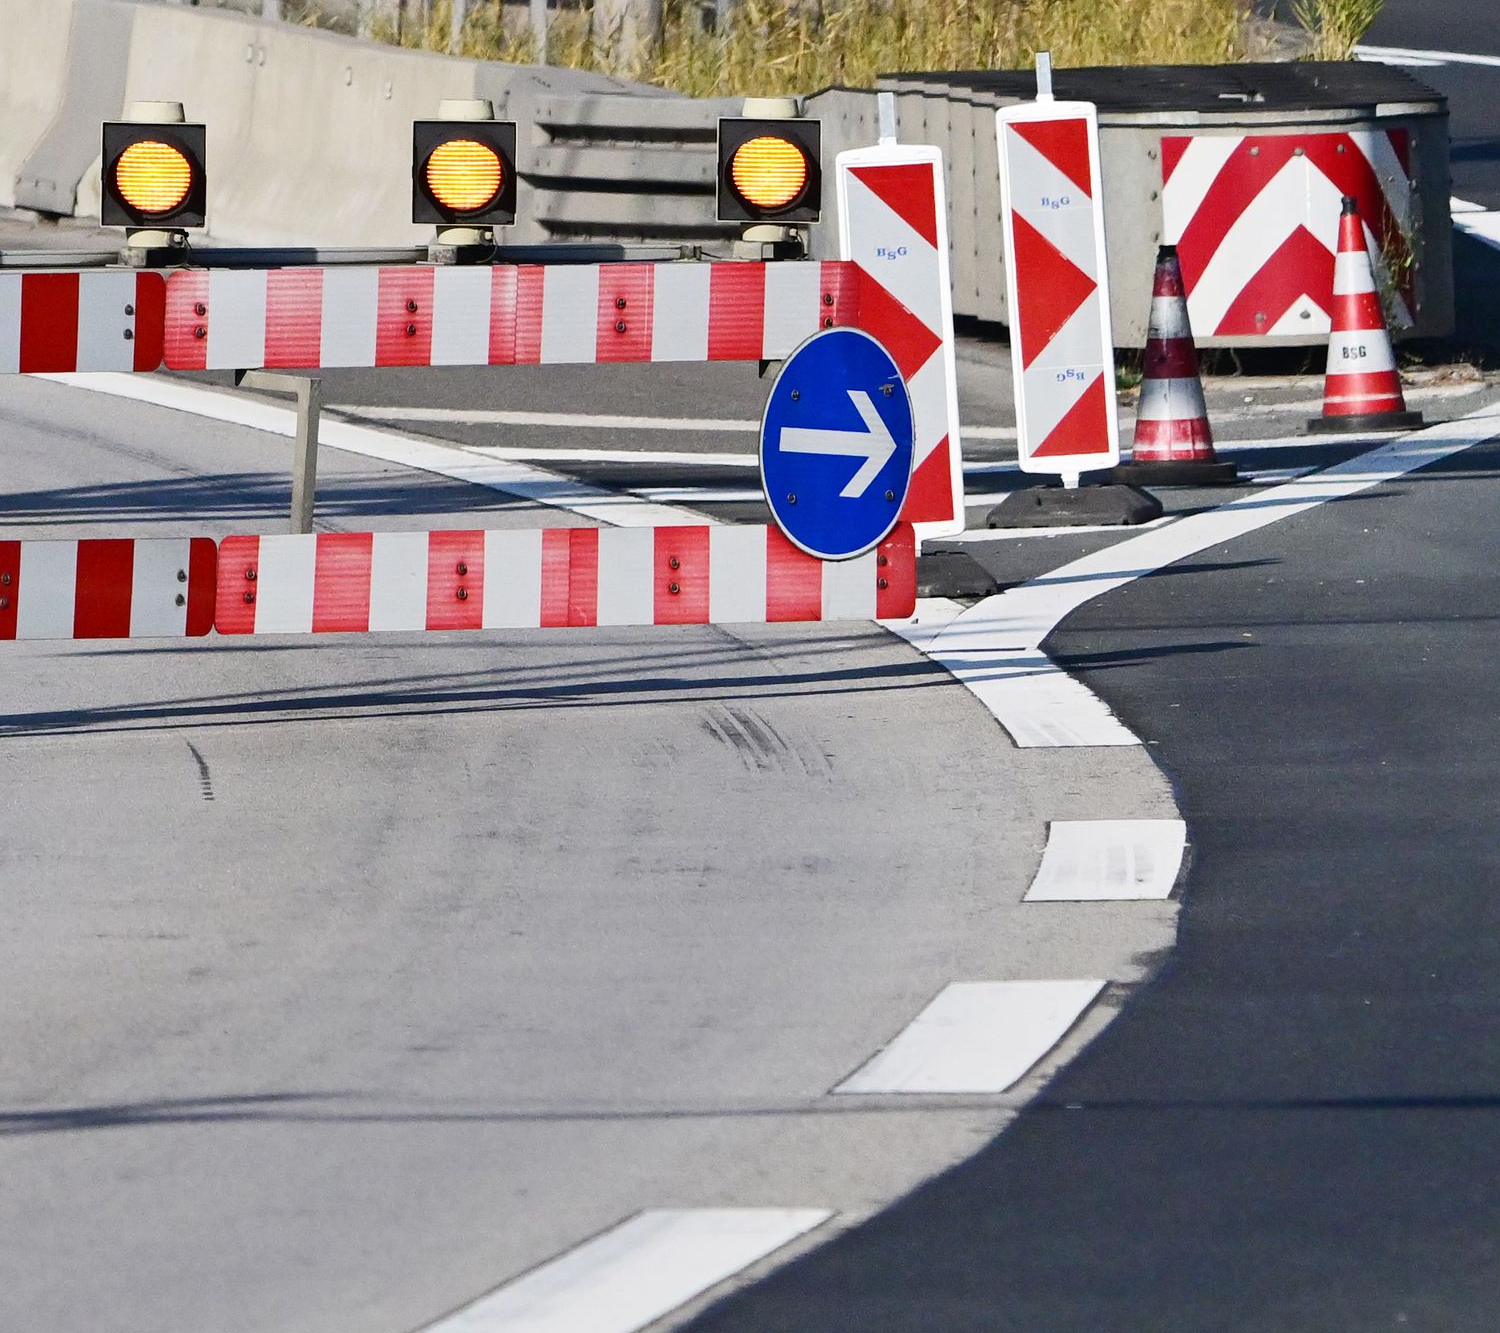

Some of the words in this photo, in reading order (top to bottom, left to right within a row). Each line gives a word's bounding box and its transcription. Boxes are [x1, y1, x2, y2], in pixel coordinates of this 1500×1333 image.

[1040, 196, 1071, 210] BSG
[876, 245, 908, 261] BSG
[1342, 345, 1367, 360] BSG
[1055, 368, 1086, 383] BSG
